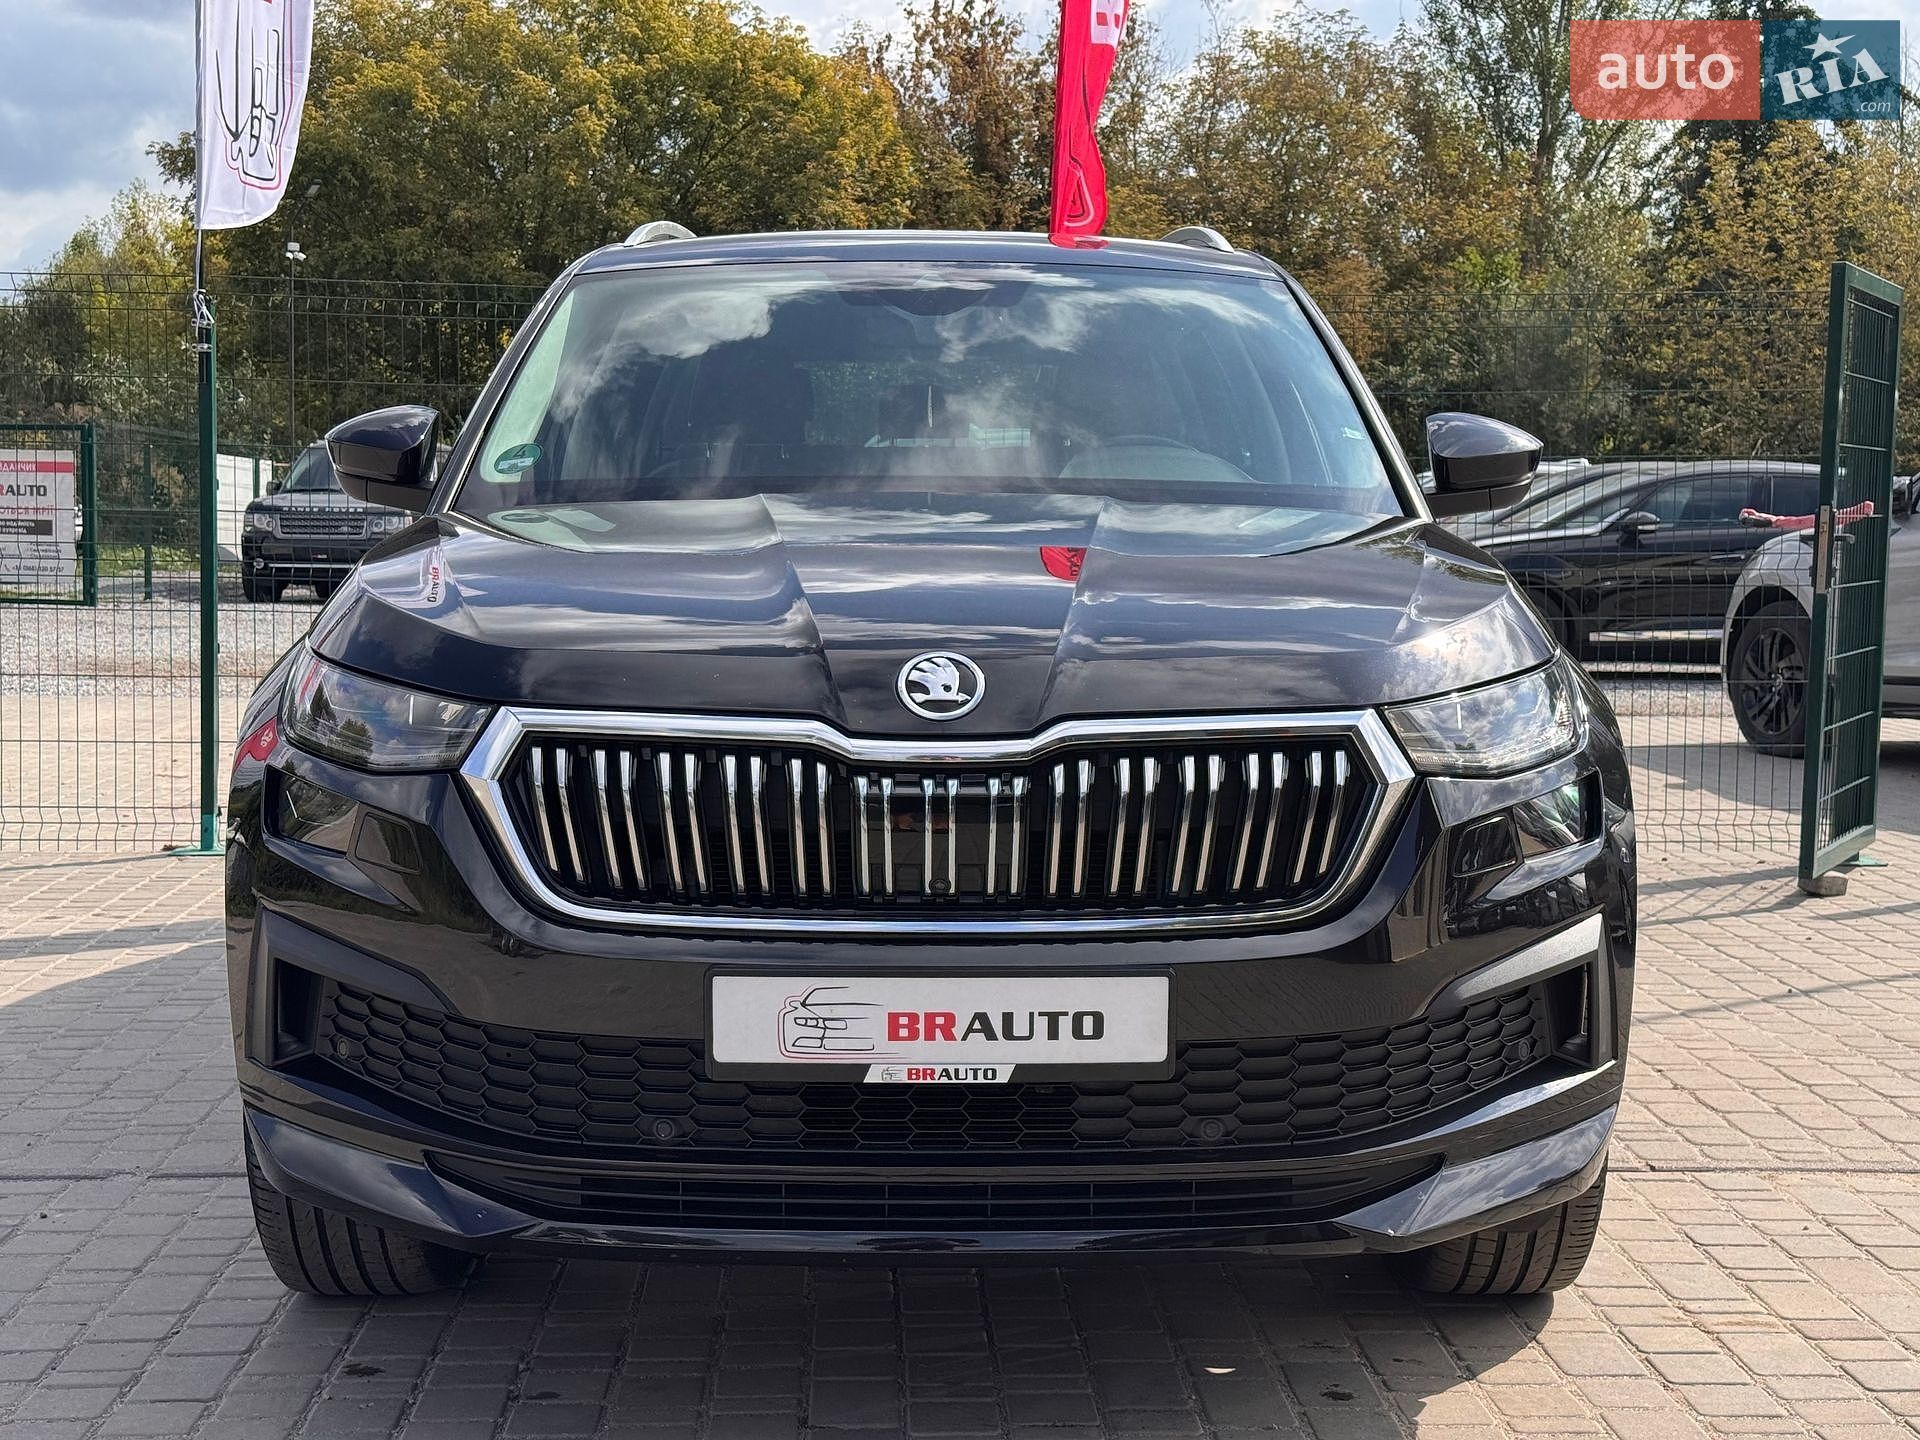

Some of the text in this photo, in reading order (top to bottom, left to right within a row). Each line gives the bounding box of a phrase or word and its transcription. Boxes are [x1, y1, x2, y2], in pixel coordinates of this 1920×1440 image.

[513, 445, 527, 458] 4
[427, 566, 440, 603] BRAUTO
[886, 1010, 1105, 1042] BRAUTO
[907, 1067, 998, 1081] BRAUTO
